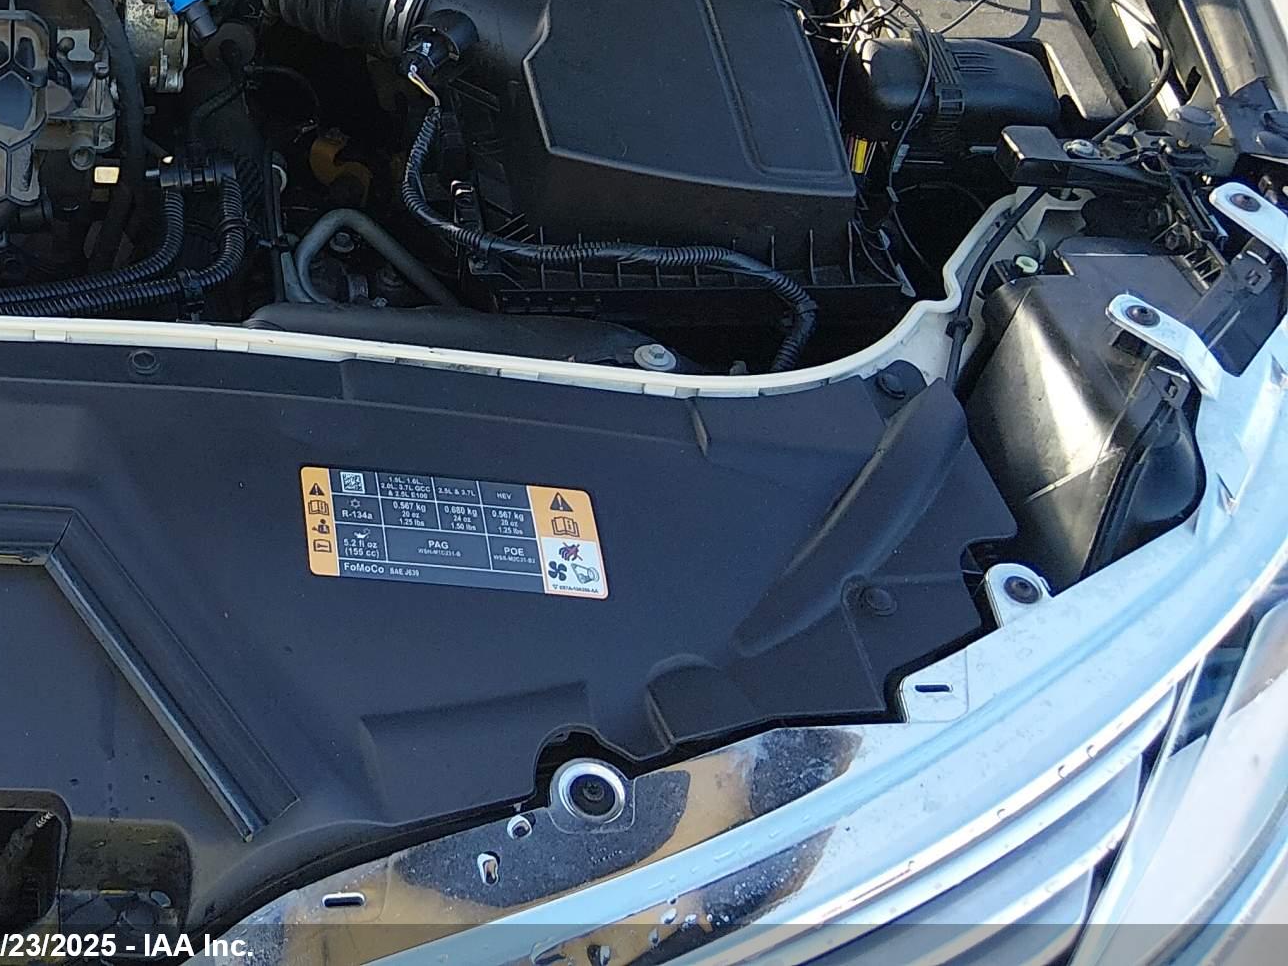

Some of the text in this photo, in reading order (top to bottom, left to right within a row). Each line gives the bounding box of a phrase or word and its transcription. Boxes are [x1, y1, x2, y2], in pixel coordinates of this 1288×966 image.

[496, 491, 513, 500] HEV
[392, 501, 426, 512] 0.567 kg
[342, 510, 373, 519] R-134a
[467, 506, 478, 517] kg
[513, 511, 524, 522] kg
[465, 523, 477, 531] lbs
[513, 527, 524, 535] lbs
[343, 538, 357, 547] 5.2
[428, 540, 449, 549] PAG
[365, 549, 380, 559] cc)
[504, 547, 524, 556] POE
[343, 562, 385, 574] FoMoCo
